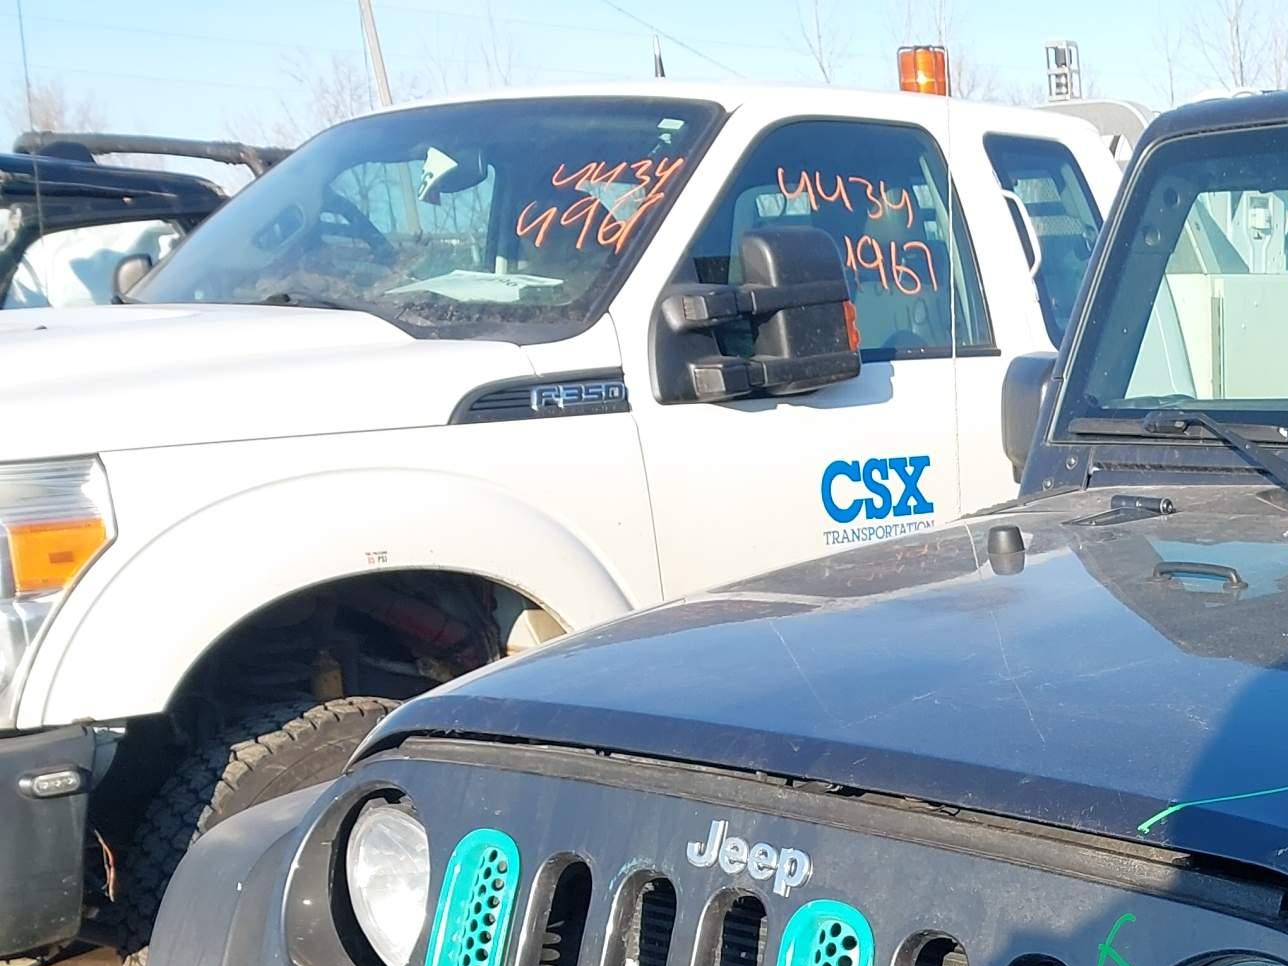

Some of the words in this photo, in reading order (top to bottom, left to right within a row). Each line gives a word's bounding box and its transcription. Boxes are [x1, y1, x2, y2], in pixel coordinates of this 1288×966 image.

[778, 167, 914, 228] 4434
[821, 456, 934, 523] CSX
[686, 820, 813, 898] Jeep
